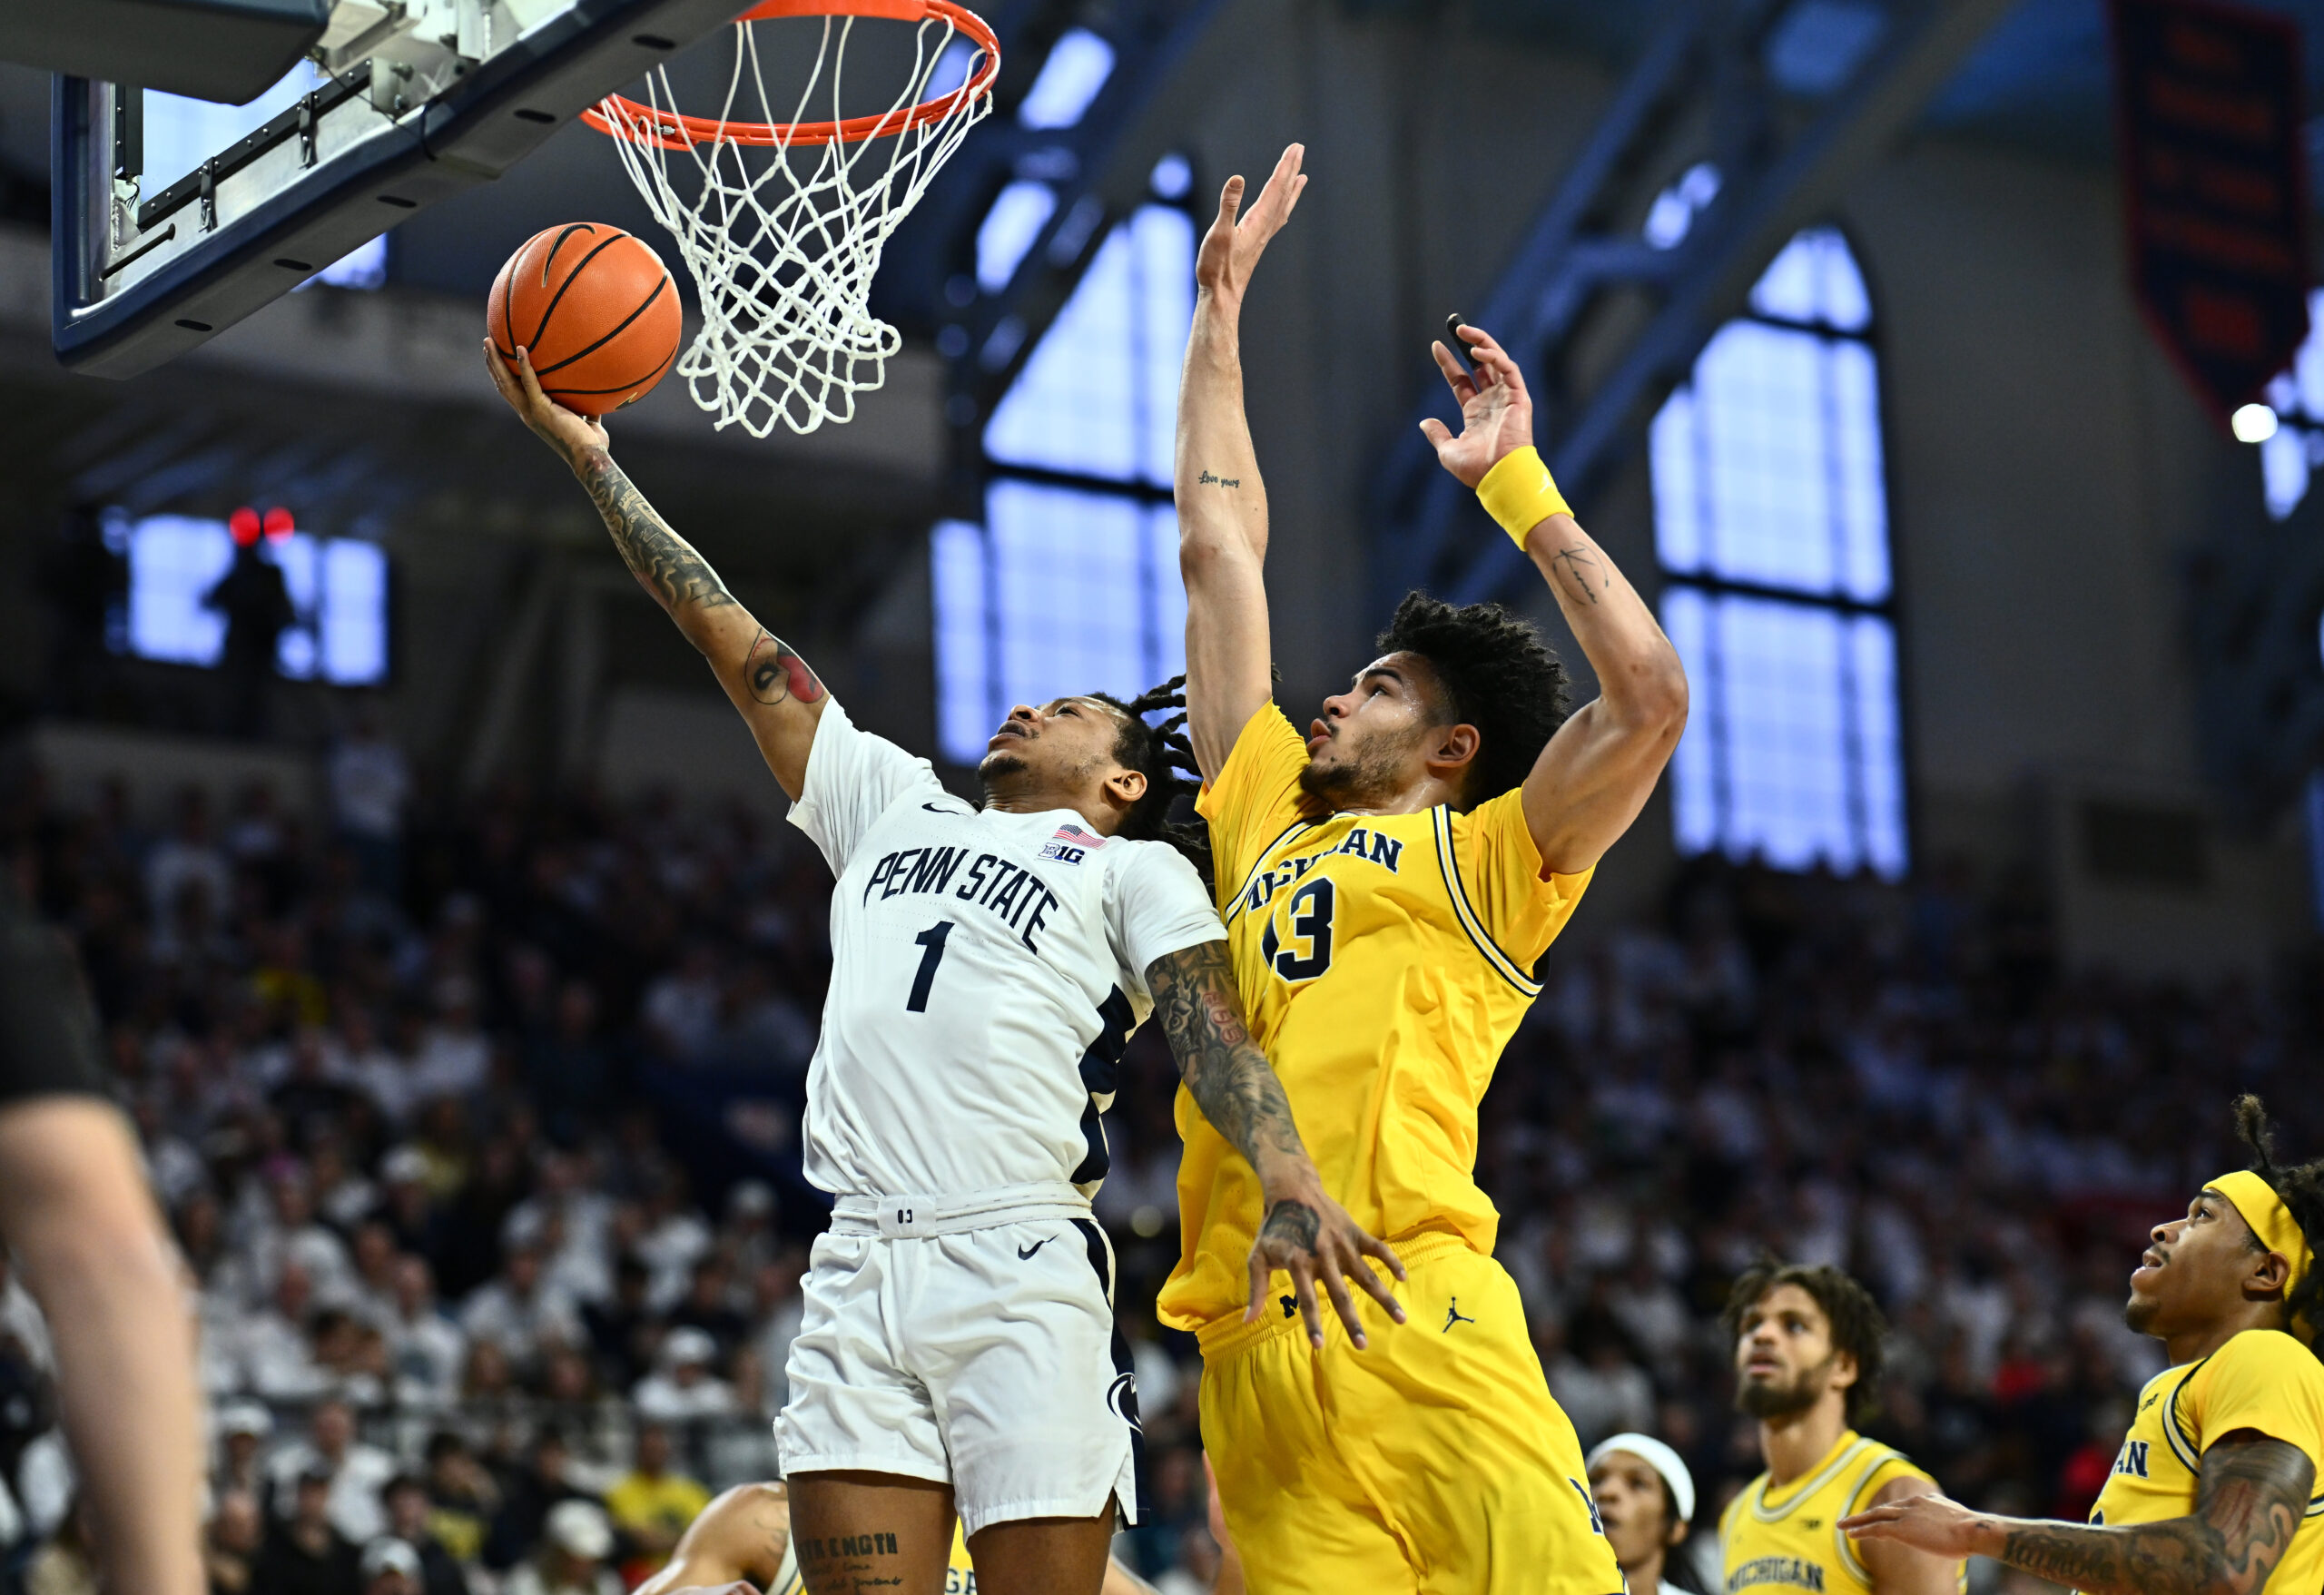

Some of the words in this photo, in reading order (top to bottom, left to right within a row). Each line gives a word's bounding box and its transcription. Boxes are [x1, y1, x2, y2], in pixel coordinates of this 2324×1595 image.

[863, 846, 970, 911] PENN
[957, 853, 1059, 956] STATE
[905, 920, 956, 1014] 1
